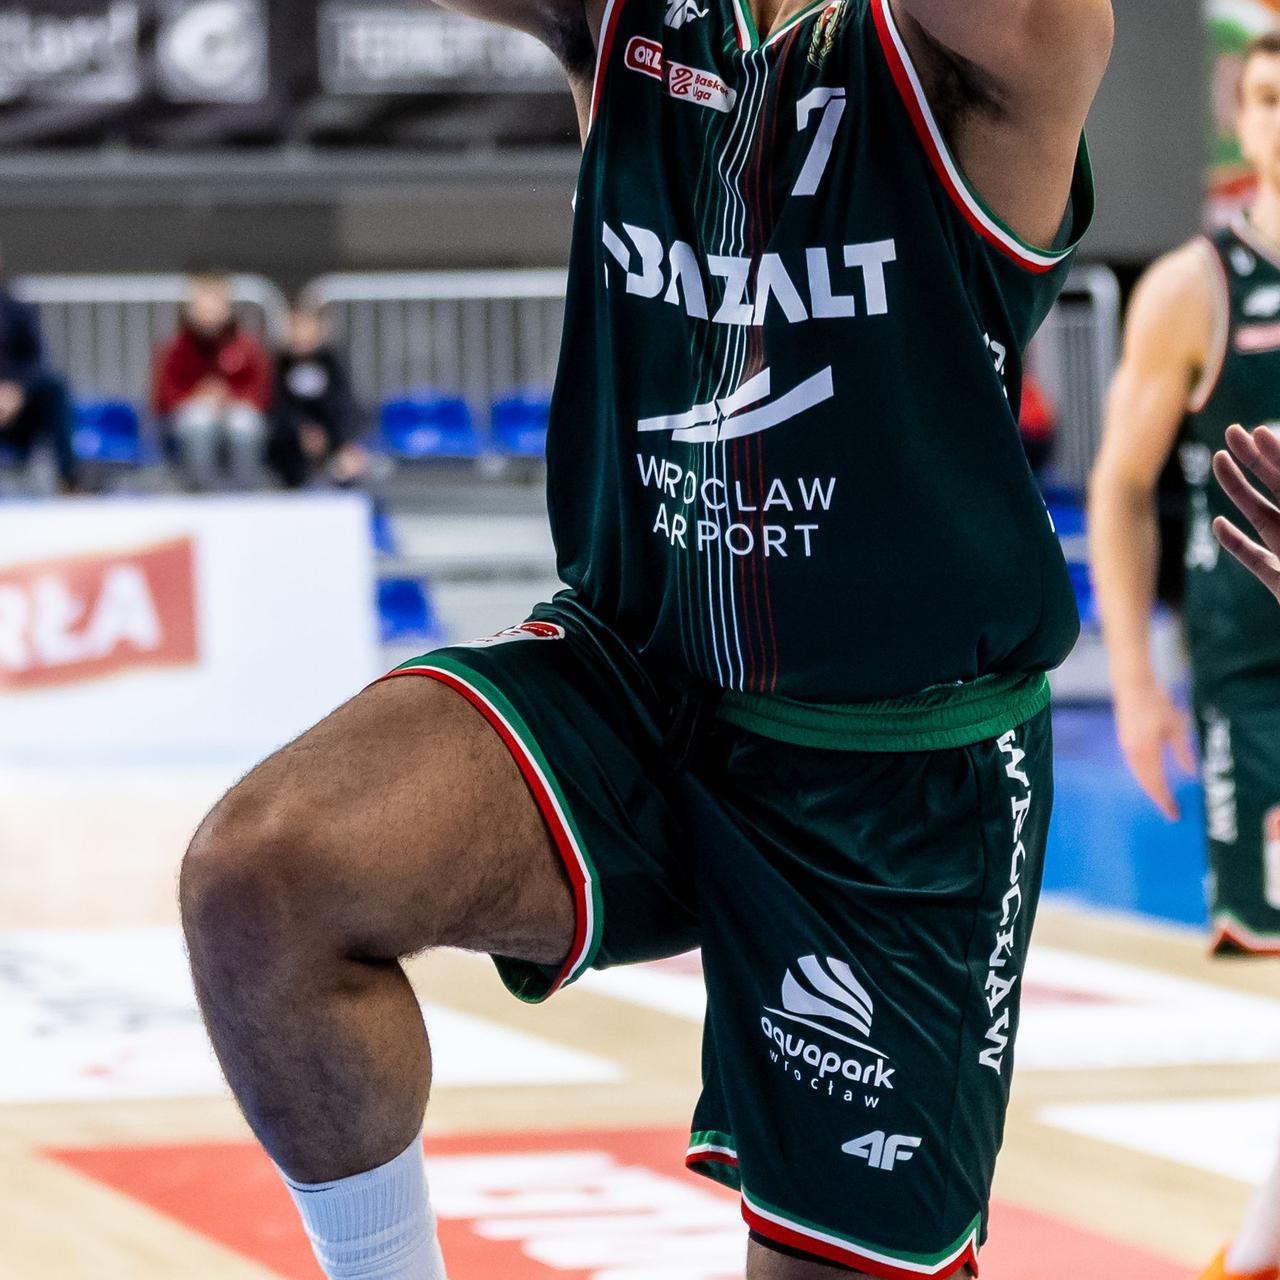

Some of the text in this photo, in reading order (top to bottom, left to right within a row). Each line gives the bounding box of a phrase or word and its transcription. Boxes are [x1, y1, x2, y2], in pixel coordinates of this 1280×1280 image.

[633, 45, 662, 71] ORL
[790, 86, 847, 197] 7
[602, 220, 897, 326] BAZALT
[636, 453, 837, 512] WROCLAW
[760, 1015, 897, 1090] aquapark
[768, 1050, 880, 1109] wrocław
[840, 1129, 923, 1172] 4F
